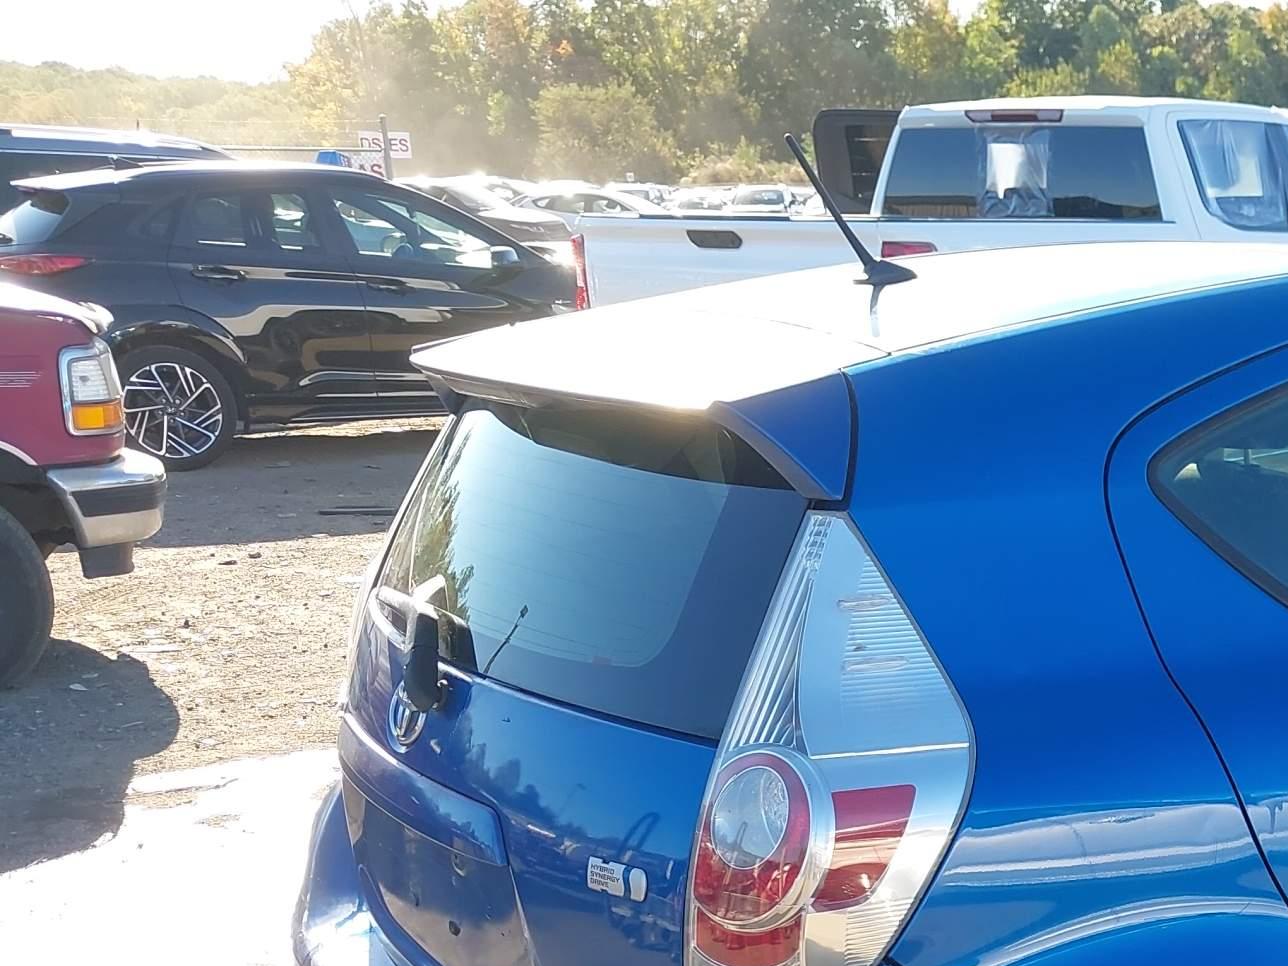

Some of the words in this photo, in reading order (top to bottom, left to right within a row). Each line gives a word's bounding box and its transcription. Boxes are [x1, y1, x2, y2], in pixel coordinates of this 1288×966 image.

[591, 864, 615, 875] HYBRID
[590, 871, 620, 884] SYNERGY
[590, 878, 610, 888] DRIVE
